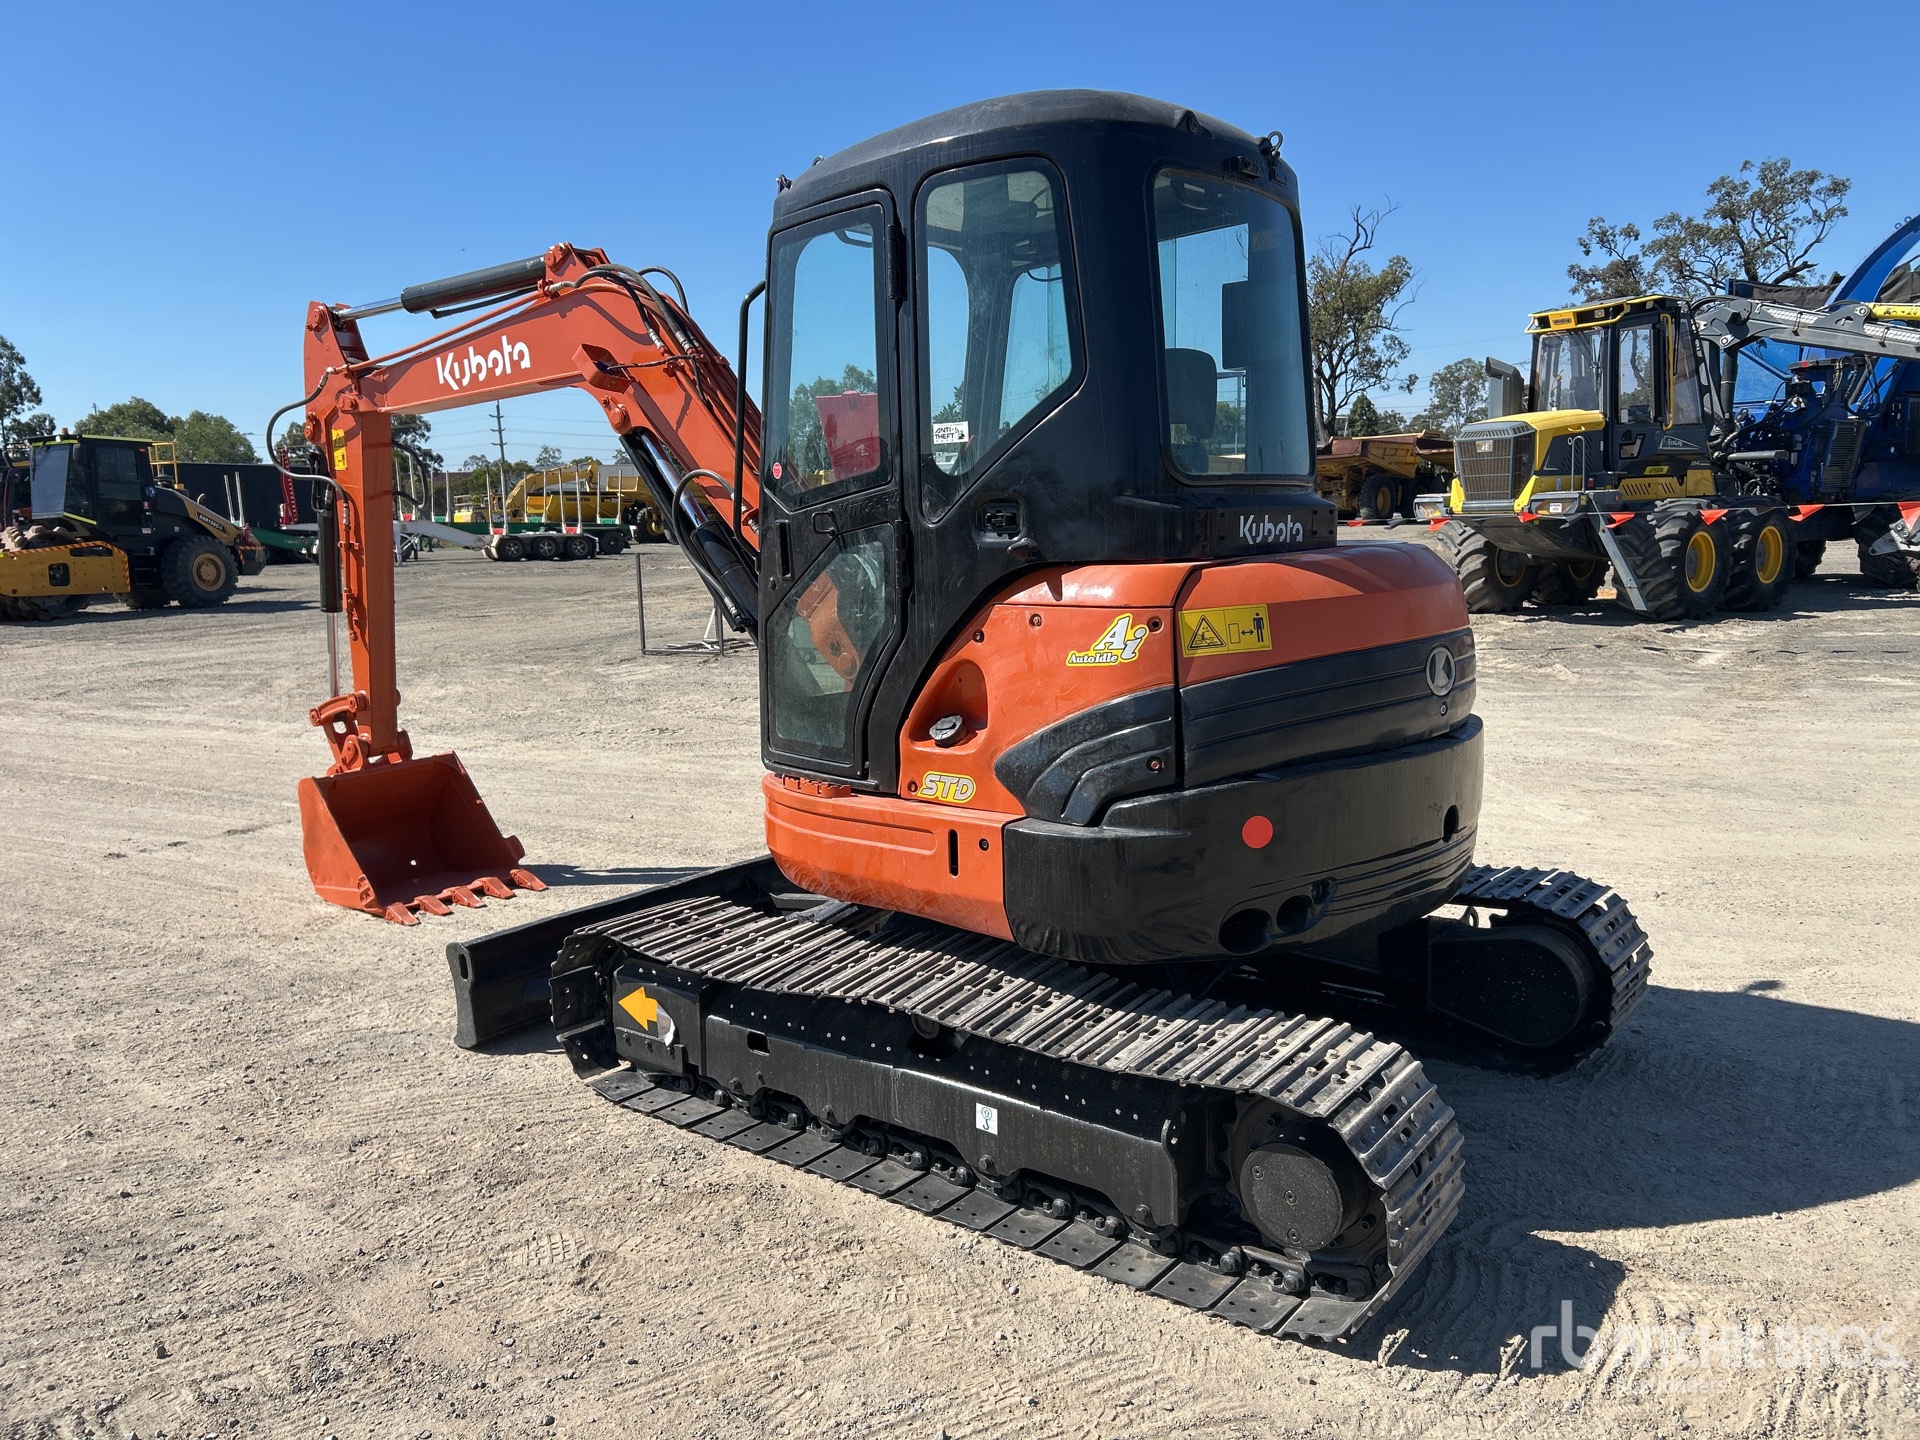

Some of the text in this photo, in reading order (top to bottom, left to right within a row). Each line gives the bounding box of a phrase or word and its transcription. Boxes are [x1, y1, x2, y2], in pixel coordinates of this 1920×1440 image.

[436, 335, 531, 391] Kubota
[935, 432, 955, 440] THEFT
[1239, 514, 1303, 545] Kubota
[1068, 652, 1119, 665] AutoIdle
[920, 773, 975, 801] STD
